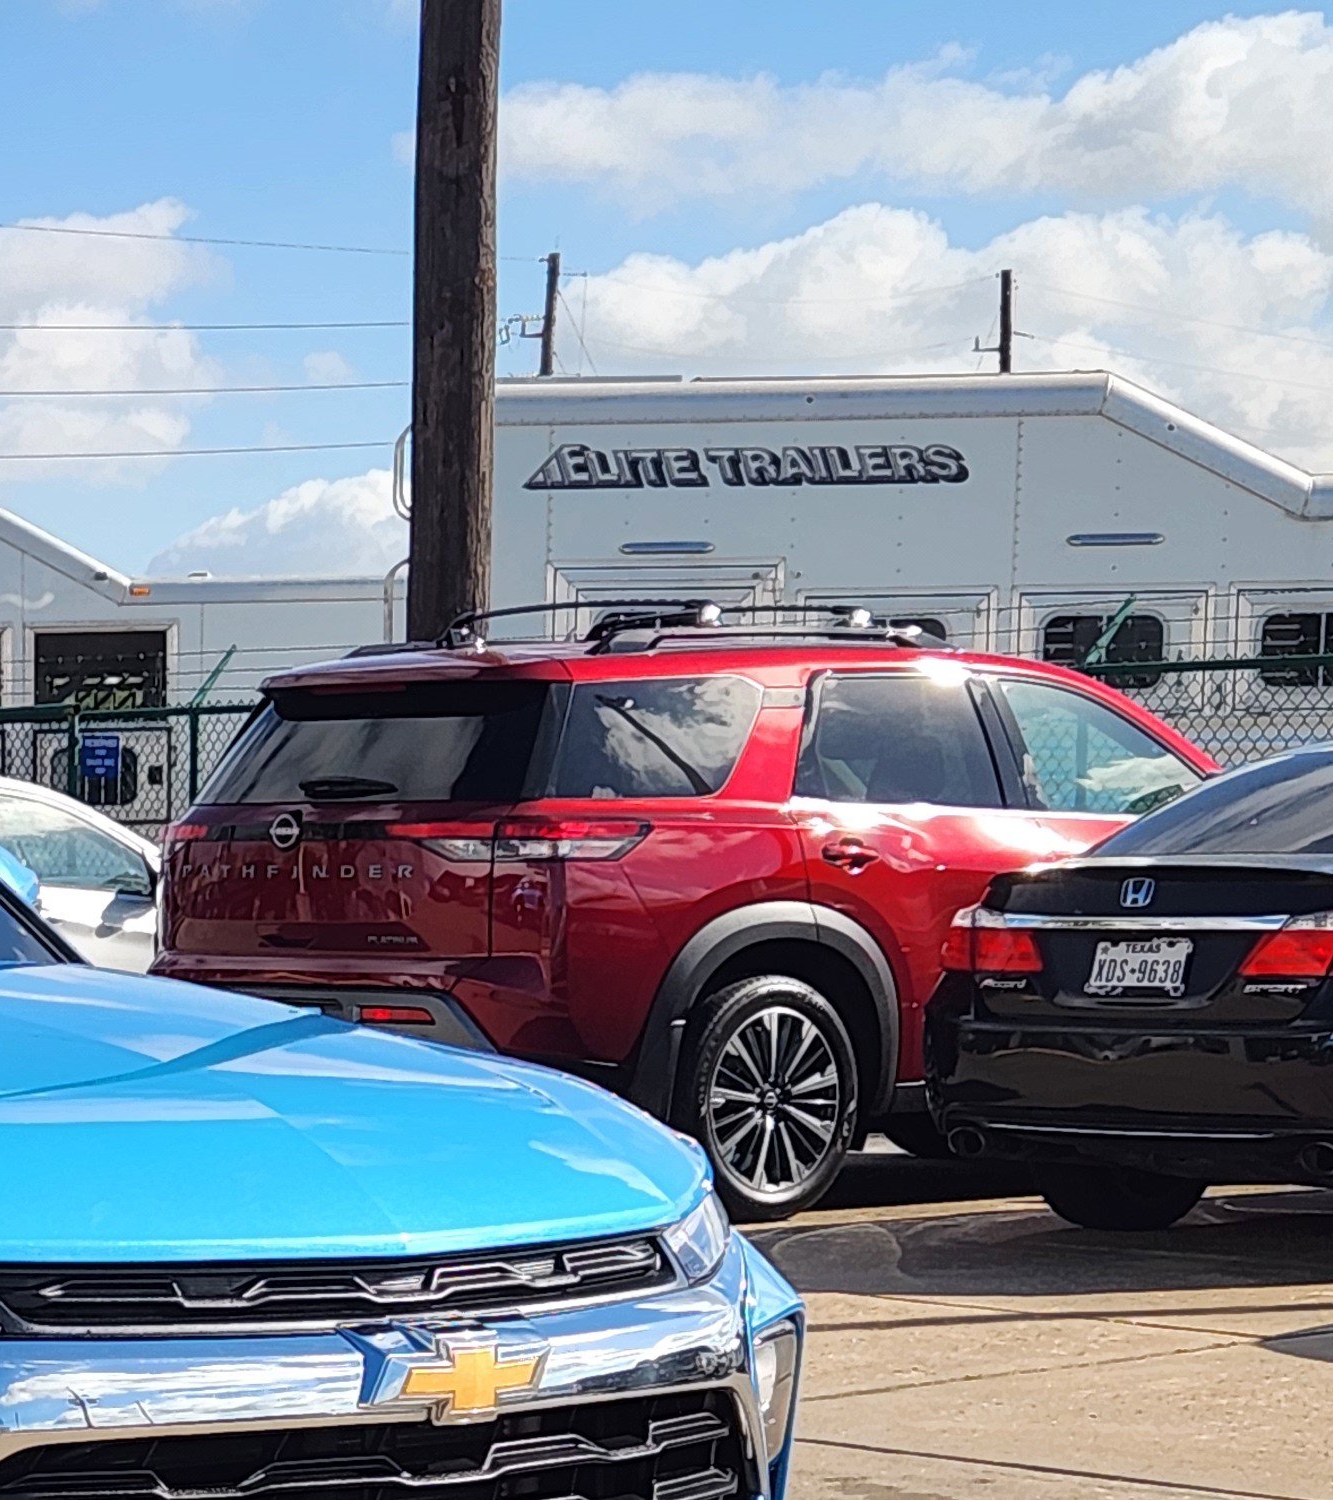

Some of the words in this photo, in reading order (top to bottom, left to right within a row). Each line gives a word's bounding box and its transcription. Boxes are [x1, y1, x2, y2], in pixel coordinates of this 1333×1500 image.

[523, 444, 710, 489] ELITE
[704, 443, 971, 487] TRAILERS
[182, 864, 414, 879] PATHFINDER
[1125, 942, 1162, 954] TEXAS
